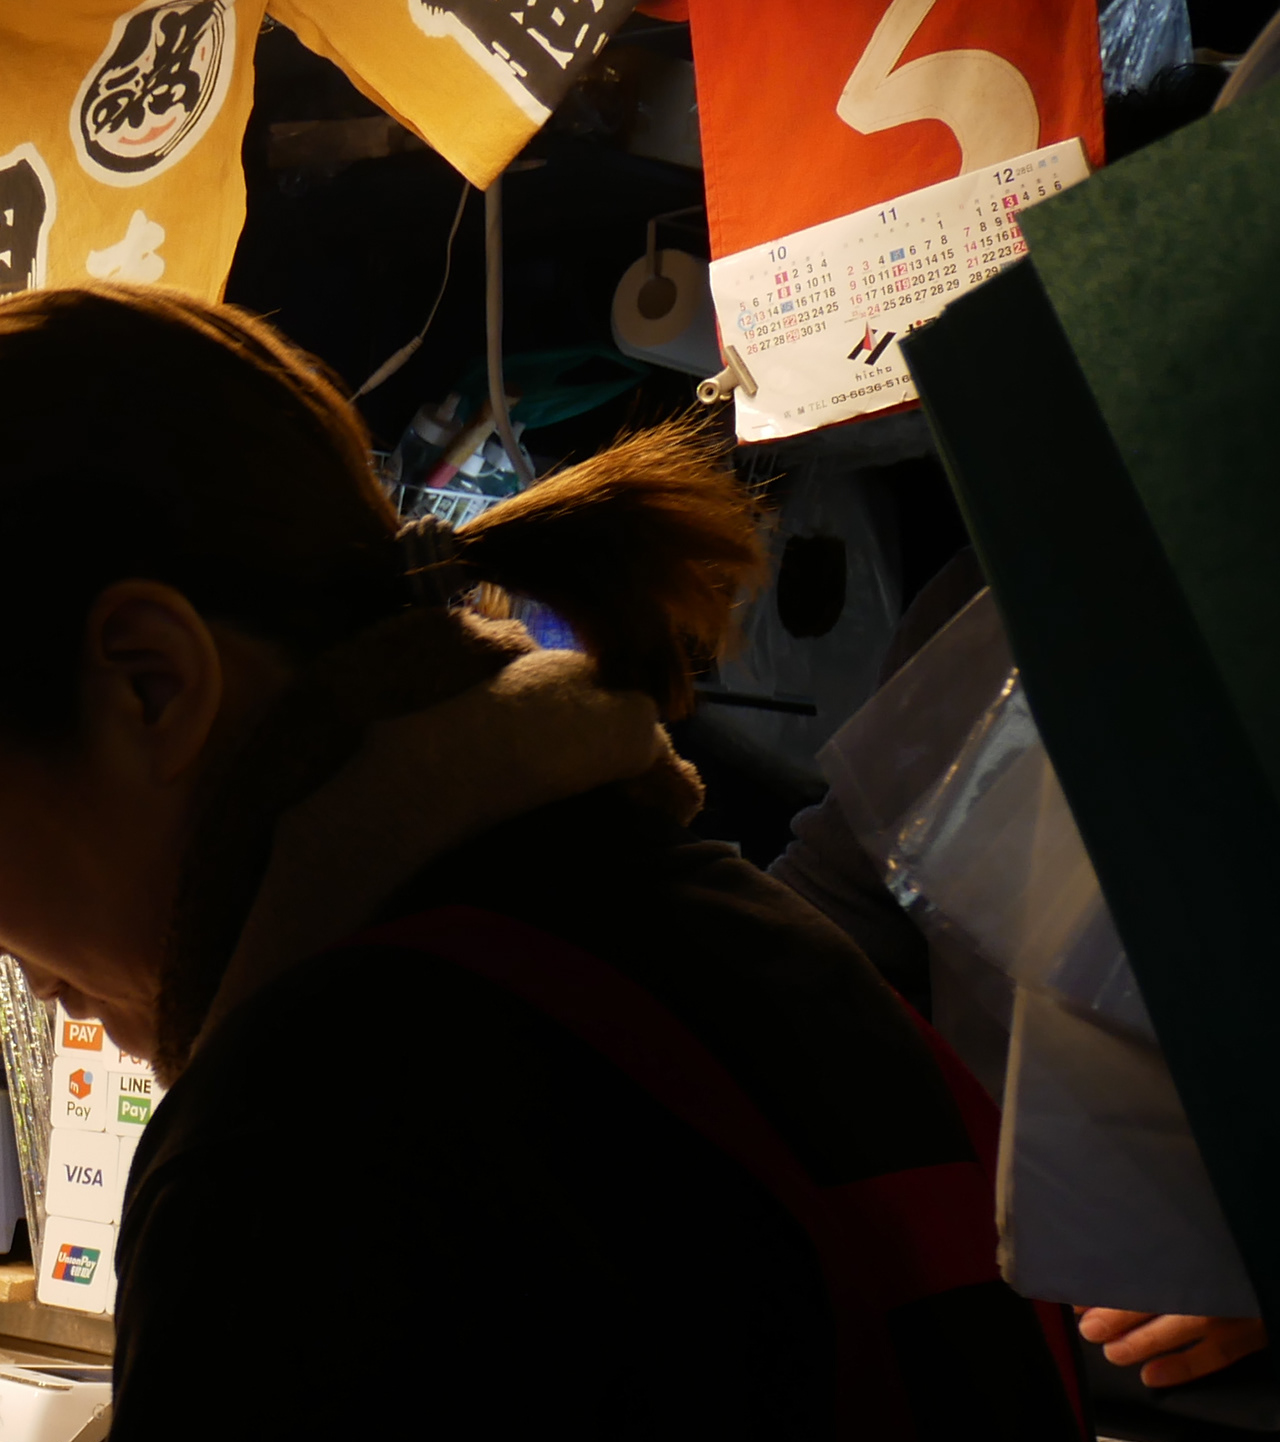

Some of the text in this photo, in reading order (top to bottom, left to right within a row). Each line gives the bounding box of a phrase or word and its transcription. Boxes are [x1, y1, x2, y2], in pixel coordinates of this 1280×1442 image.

[993, 168, 1015, 186] 12
[878, 207, 897, 224] 11
[769, 246, 787, 262] 10
[831, 374, 914, 405] 03-6636-516
[69, 1023, 97, 1043] PAY
[120, 1076, 151, 1094] LINE
[67, 1101, 91, 1121] Pay
[122, 1101, 147, 1121] Pay
[63, 1163, 103, 1187] VISA
[58, 1251, 97, 1271] UnionPay
